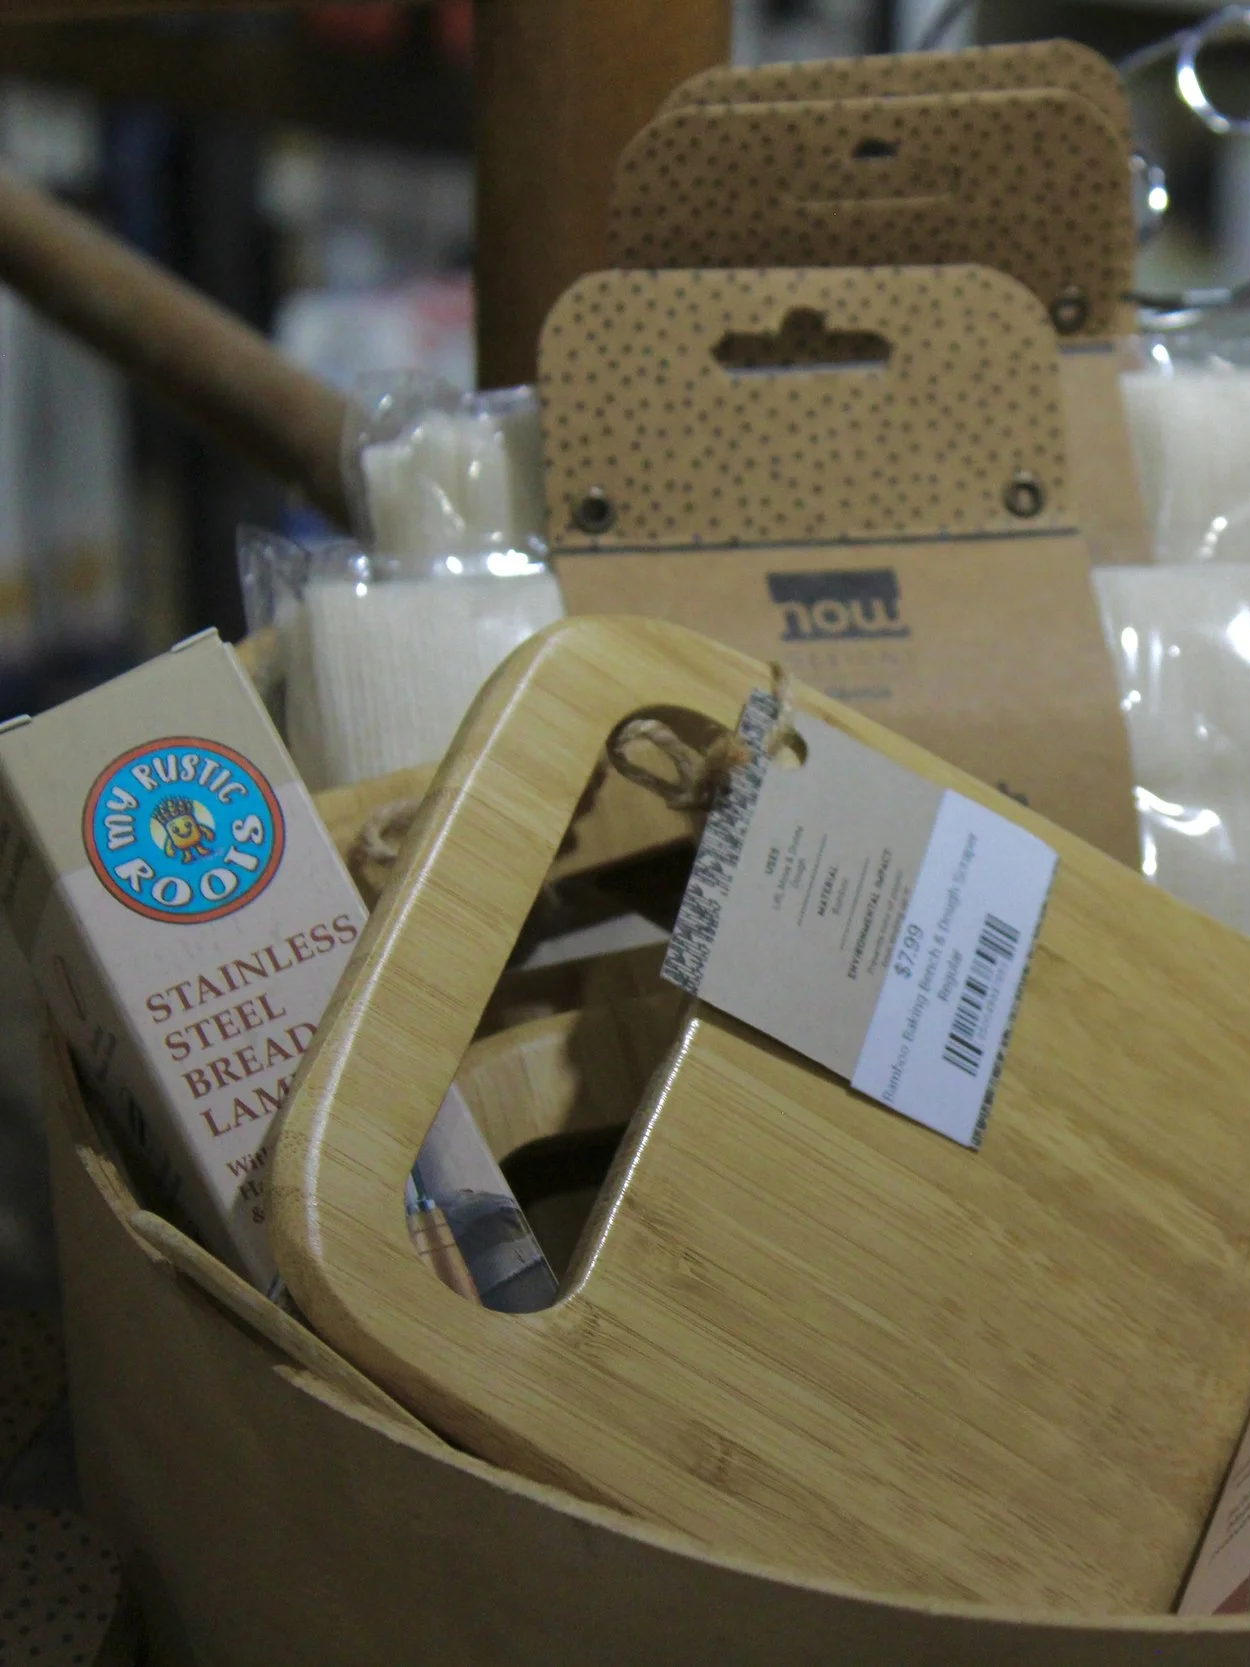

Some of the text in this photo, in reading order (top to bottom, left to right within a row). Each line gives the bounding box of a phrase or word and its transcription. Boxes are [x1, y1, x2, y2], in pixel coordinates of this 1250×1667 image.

[131, 753, 249, 804] RUSTIC
[114, 814, 264, 907] ROOTS
[765, 846, 780, 875] USES
[817, 864, 839, 917] MATERIAL
[847, 847, 893, 980] ENVIRONMENTAL IMPACT
[146, 914, 358, 1024] STAINLESS
[894, 923, 925, 980] $7.99
[936, 948, 963, 1002] Regular
[164, 993, 287, 1062] STEEL
[882, 1042, 912, 1102] Bamboo
[902, 991, 931, 1042] Baking
[917, 948, 942, 991] Bench
[936, 888, 962, 934] Dough
[180, 1021, 319, 1099] BREAD
[200, 1072, 298, 1137] LAM
